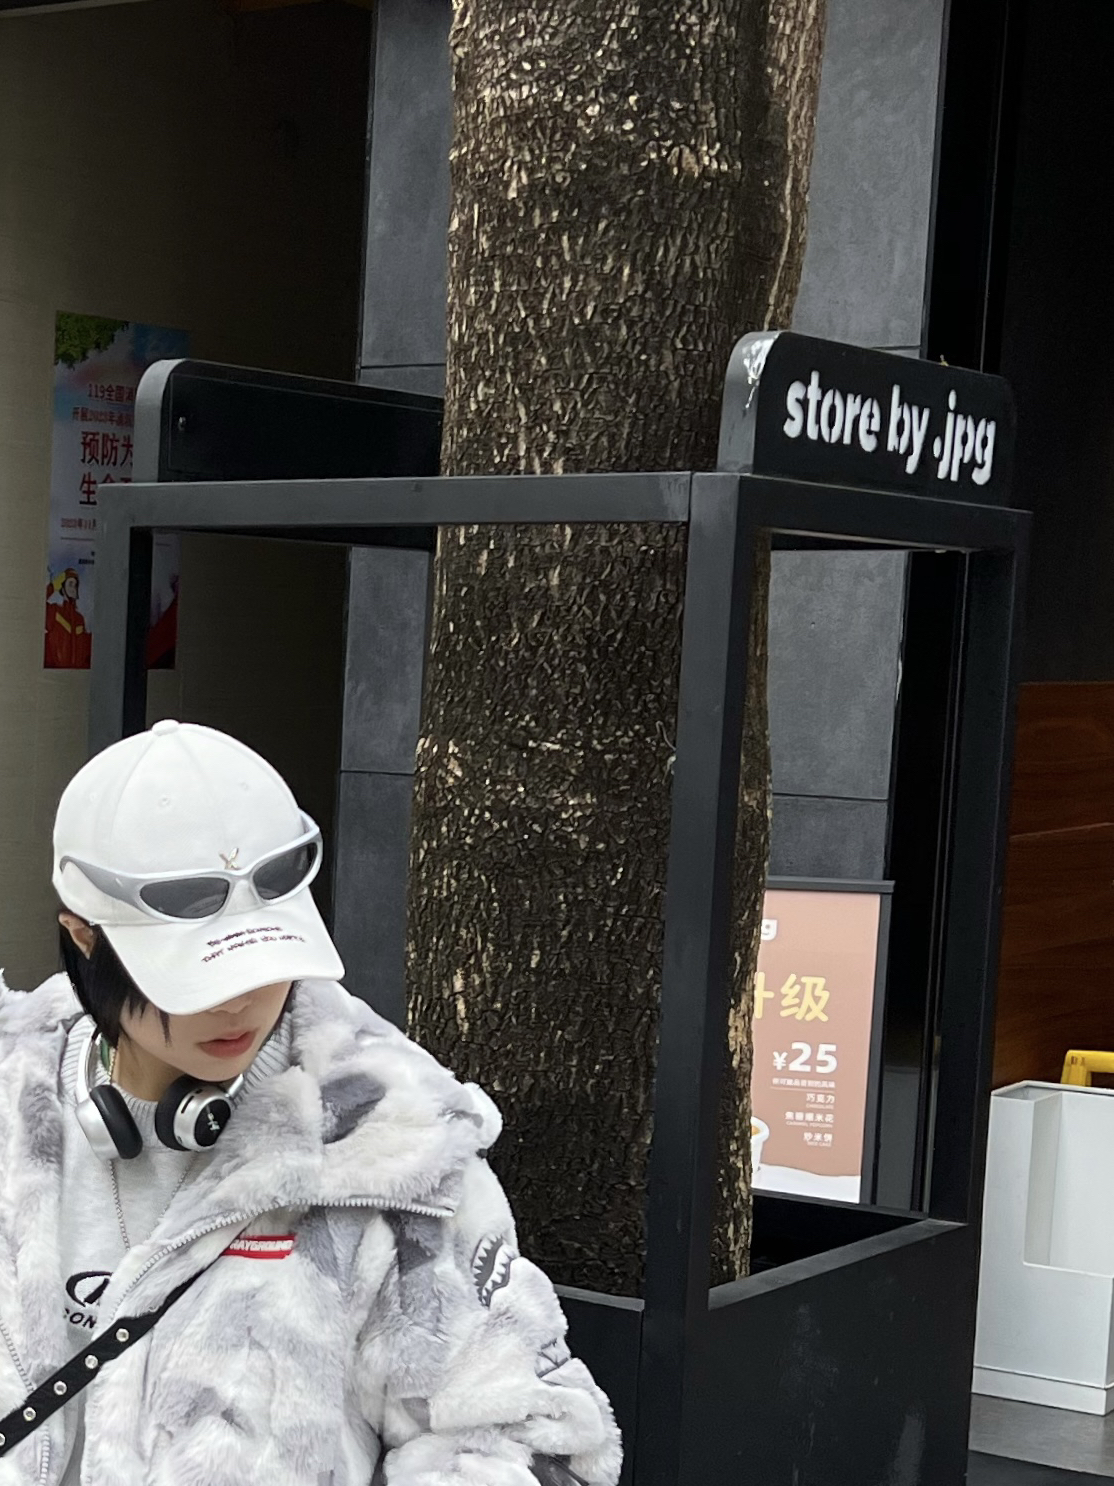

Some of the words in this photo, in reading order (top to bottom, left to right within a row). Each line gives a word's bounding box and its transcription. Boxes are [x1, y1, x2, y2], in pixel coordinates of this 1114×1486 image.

[783, 370, 881, 453] store
[887, 384, 930, 475] by
[932, 389, 996, 486] .jpg
[772, 1041, 838, 1075] ¥25
[806, 1093, 835, 1104] 巧克力
